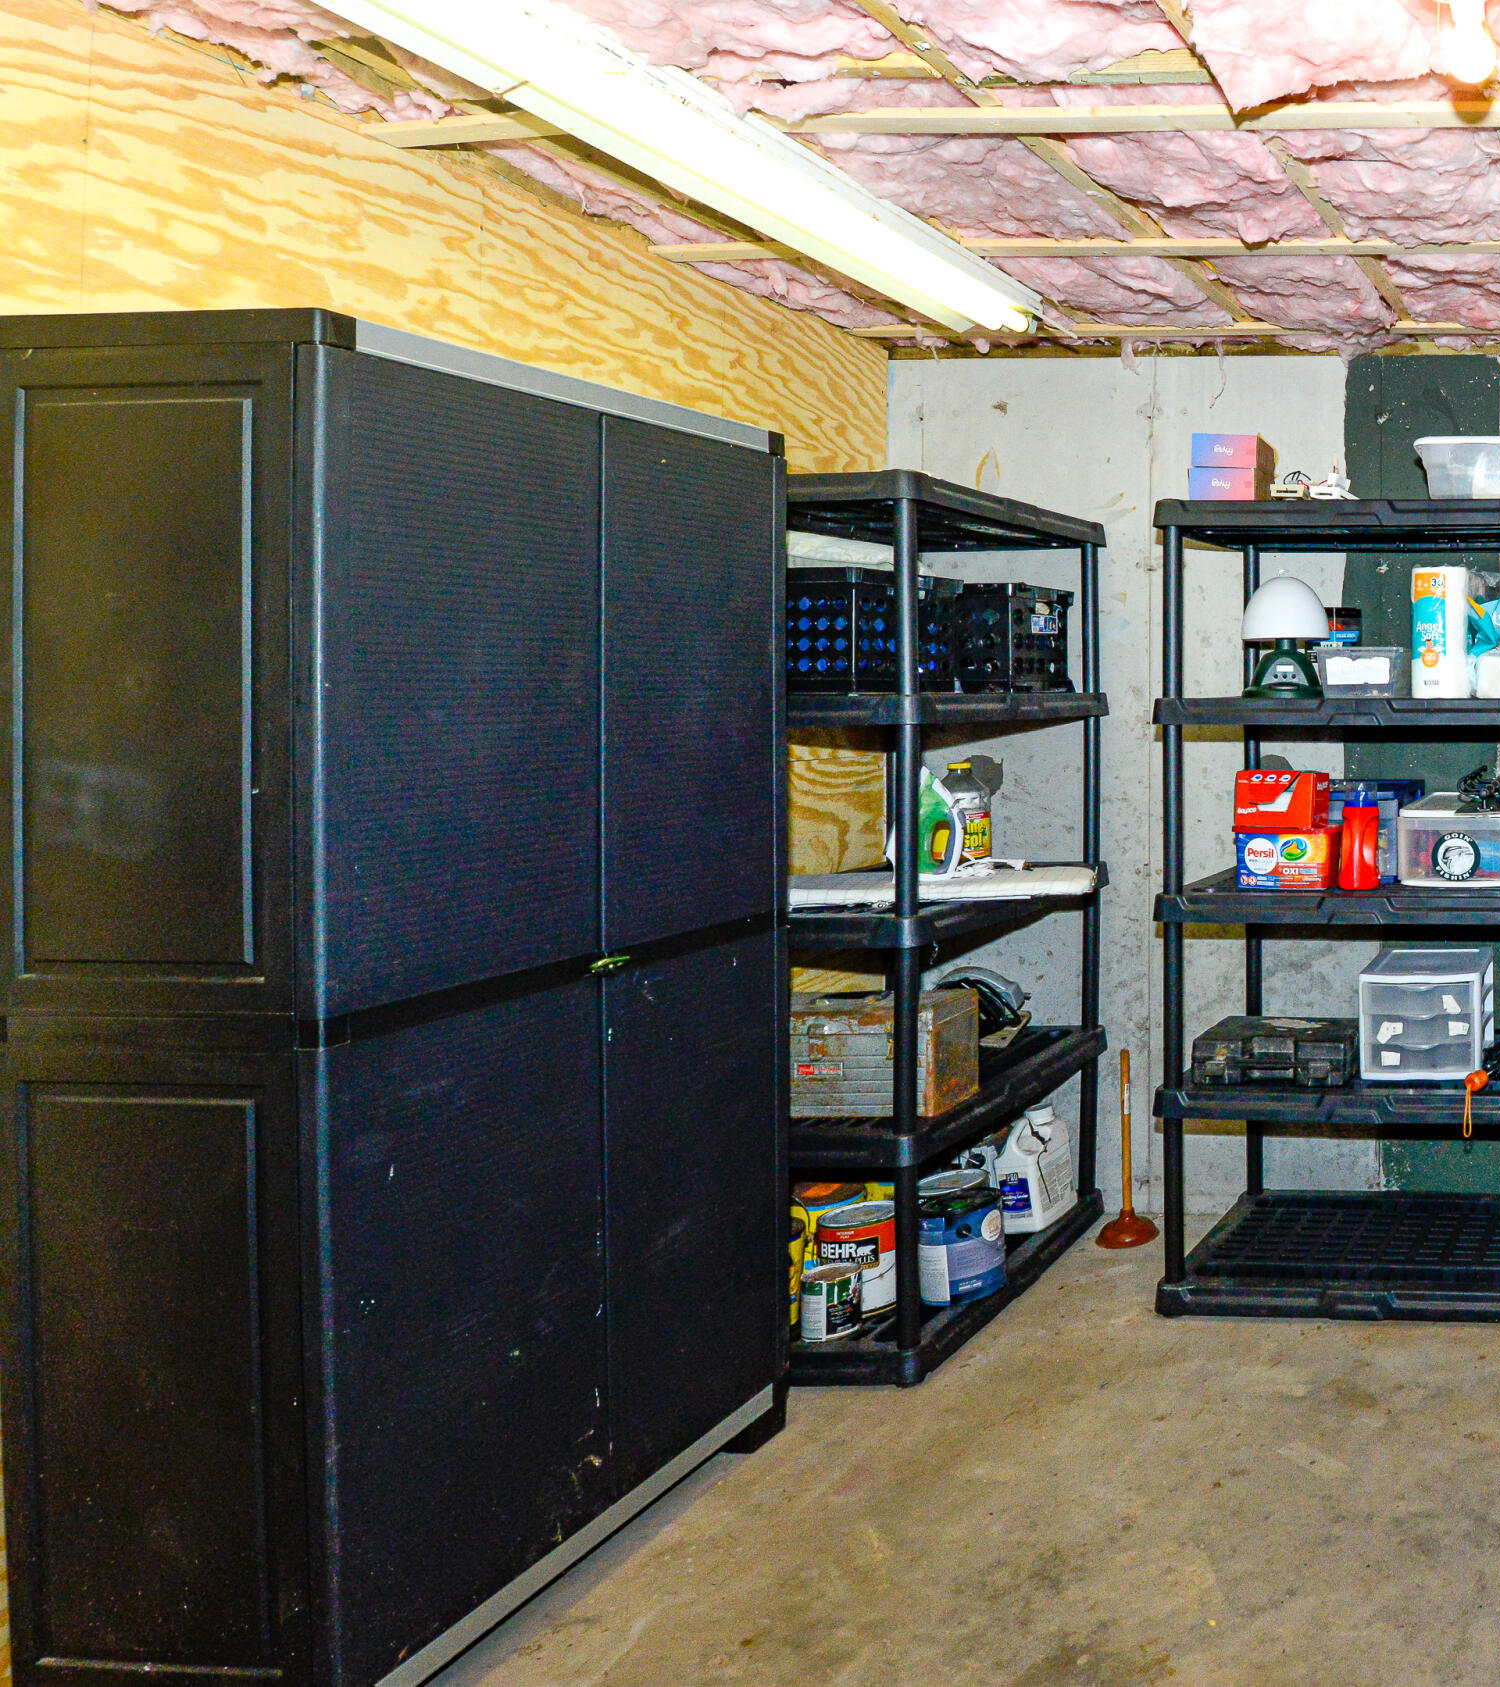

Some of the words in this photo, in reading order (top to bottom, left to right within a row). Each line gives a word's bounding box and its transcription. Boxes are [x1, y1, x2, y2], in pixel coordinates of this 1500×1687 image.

[1416, 621, 1444, 634] Angel
[1247, 847, 1275, 859] Persil
[1282, 866, 1299, 875] OXI
[820, 1242, 857, 1259] BEHR
